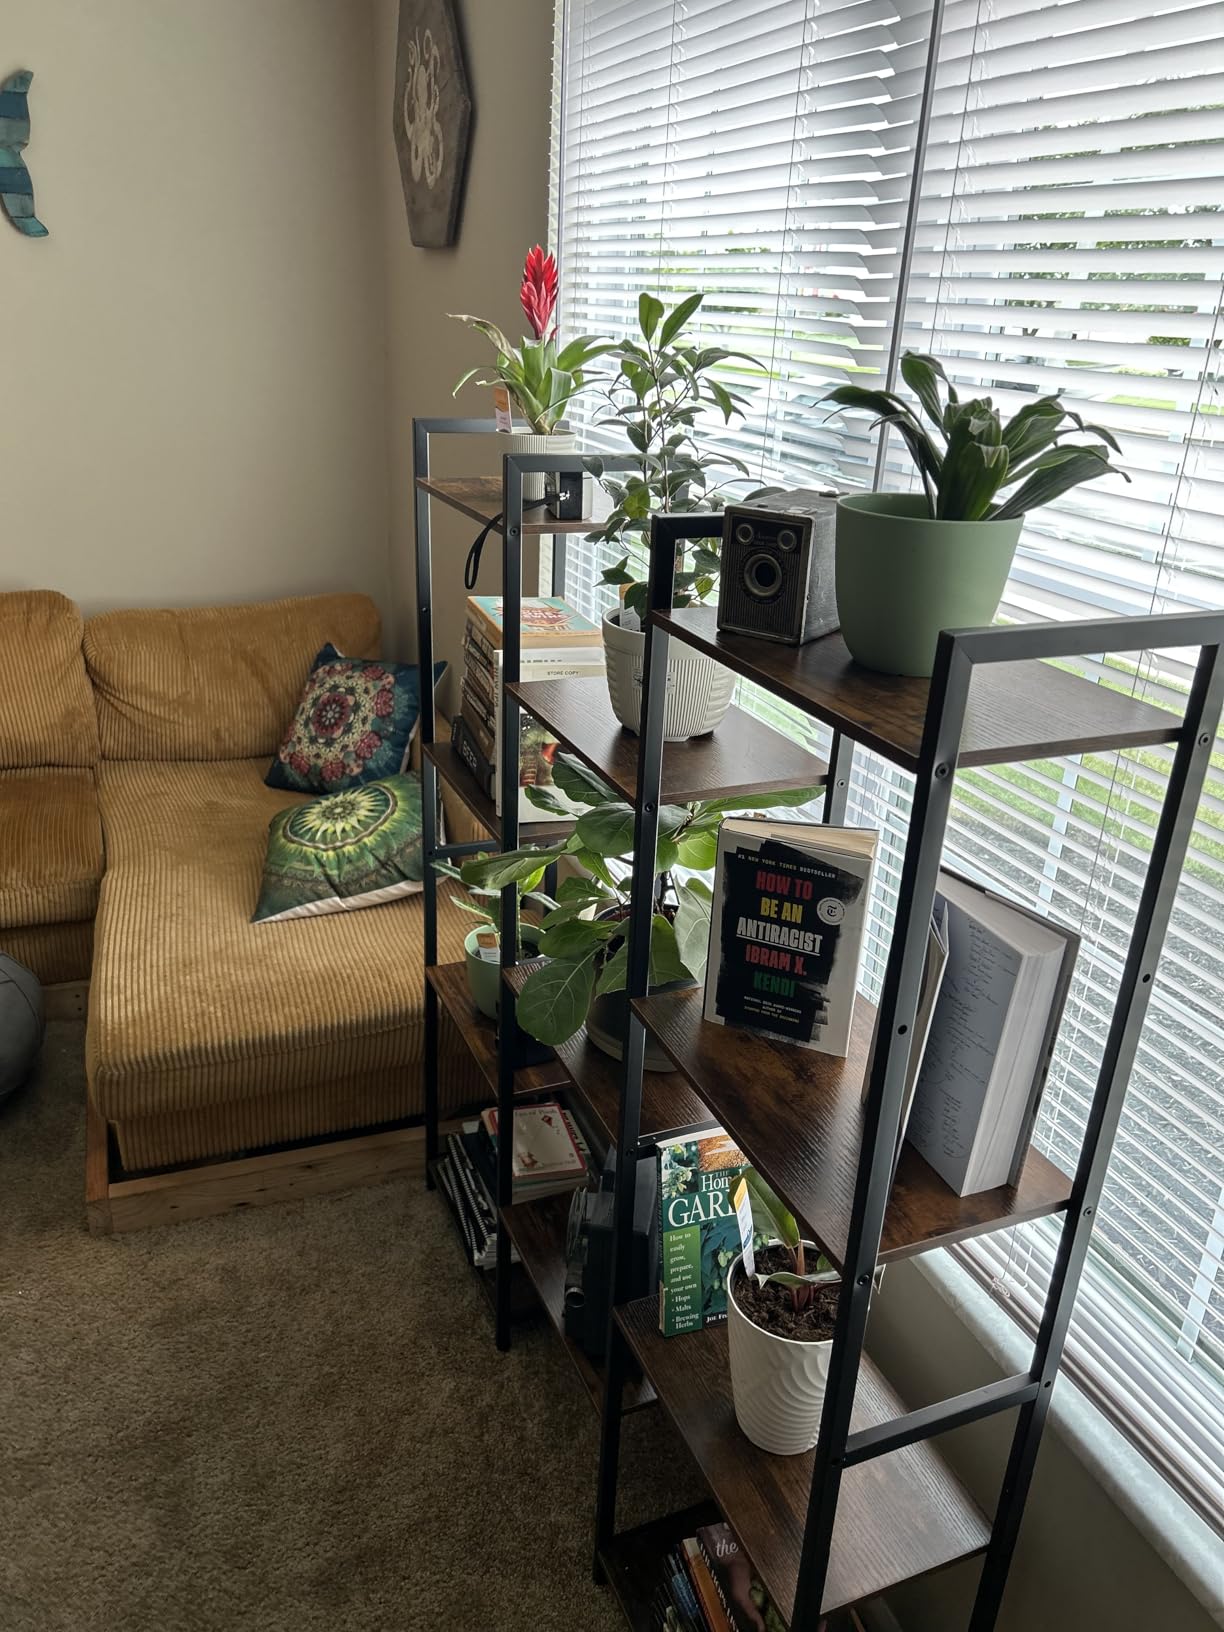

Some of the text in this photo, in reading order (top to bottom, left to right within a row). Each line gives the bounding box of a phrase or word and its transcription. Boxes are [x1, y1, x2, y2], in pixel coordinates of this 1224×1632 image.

[762, 858, 776, 866] YORK
[779, 862, 797, 871] TIMES
[799, 866, 836, 879] BESTSELLER
[756, 870, 813, 900] HOW TO
[760, 897, 803, 924] BE AN
[736, 916, 823, 954] ANTIRACIST
[745, 943, 807, 976] IBRAM X.
[753, 971, 796, 998] KENDI
[701, 1173, 732, 1192] Hom
[668, 1189, 736, 1227] GAR
[670, 1234, 683, 1242] How
[670, 1243, 685, 1252] easily
[670, 1255, 686, 1264] grow,
[670, 1263, 693, 1275] prepare,
[670, 1274, 681, 1283] and
[670, 1286, 684, 1294] your
[675, 1313, 699, 1322] Brewing
[675, 1321, 694, 1329] Herbs
[715, 1538, 739, 1558] the
